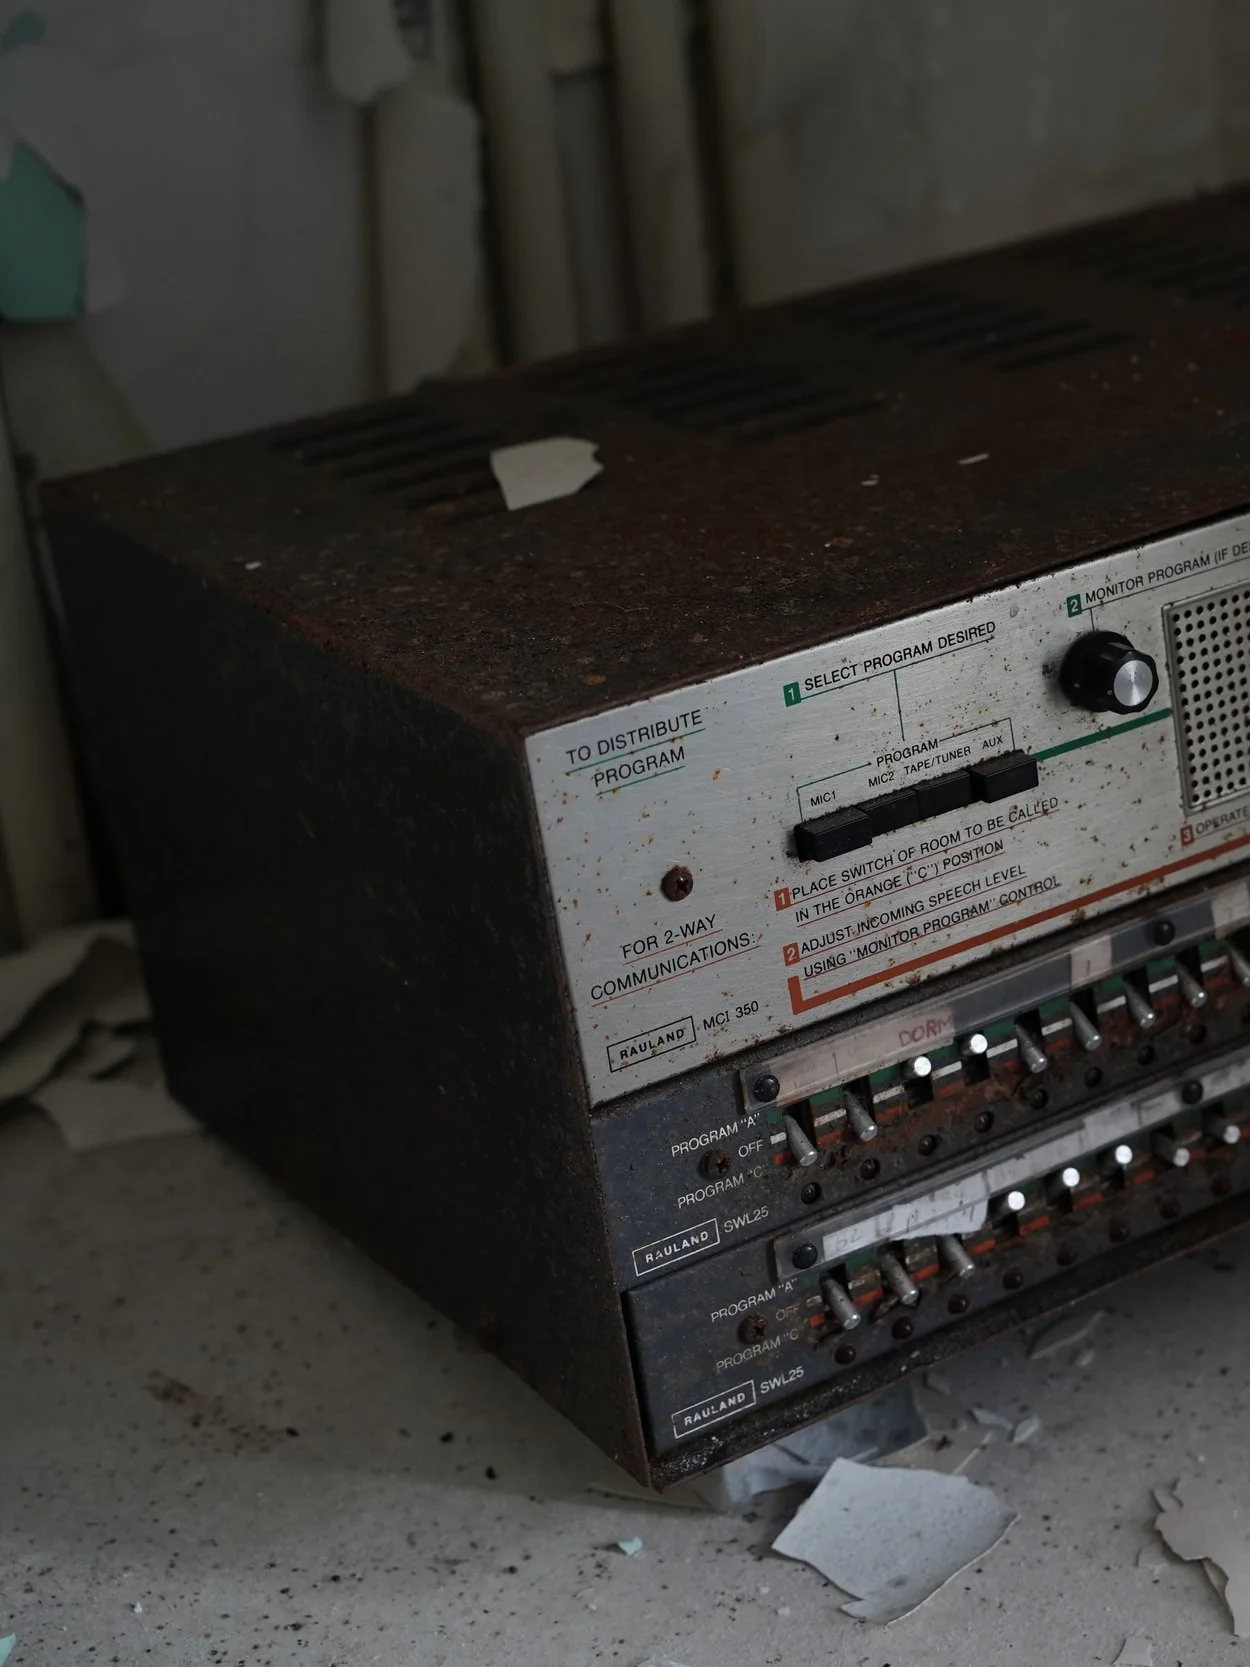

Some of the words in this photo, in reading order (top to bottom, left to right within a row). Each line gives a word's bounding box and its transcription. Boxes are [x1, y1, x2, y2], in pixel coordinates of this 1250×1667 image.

[1085, 575, 1144, 604] MONITOR
[1148, 554, 1211, 584] PROGRAM
[1214, 548, 1229, 566] (IF
[804, 664, 858, 691] SELECT
[863, 641, 934, 673] PROGRAM
[938, 621, 996, 649] DESIRED
[565, 745, 592, 765] TO
[597, 709, 703, 756] DISTRIBUTE
[868, 771, 895, 788] MIC2
[904, 746, 971, 775] TAPE/TUNER
[982, 735, 1003, 750] AUX
[876, 738, 939, 767] PROGRAM
[593, 746, 686, 788] PROGRAM
[810, 790, 837, 808] MIC1
[1195, 806, 1250, 835] OPERATE
[791, 875, 836, 900] PLACE
[842, 857, 894, 882] SWITCH
[897, 847, 916, 863] OF
[920, 831, 962, 856] ROOM
[965, 823, 983, 839] TO
[987, 816, 1004, 832] BE
[1008, 797, 1059, 824] CALLED
[795, 911, 808, 923] IN
[812, 900, 841, 918] THE
[844, 877, 902, 906] ORANGE
[942, 840, 1004, 870] POSITION
[800, 928, 851, 954] ADJUST
[857, 901, 925, 932] INCOMING
[928, 880, 982, 908] SPEECH
[985, 864, 1026, 888] LEVEL
[803, 953, 847, 978] USING
[999, 875, 1062, 906] CONTROL
[622, 935, 660, 959] FOR
[664, 914, 717, 944] 2-WAY
[590, 932, 757, 1000] COMMUNICATIONS:
[619, 1028, 685, 1060] RAULAND
[702, 1010, 731, 1031] MCI
[735, 1000, 760, 1019] 350
[898, 1015, 954, 1048] DORM
[671, 1122, 739, 1157] PROGRAM
[738, 1139, 764, 1158] OFF
[677, 1173, 745, 1209] PROGRAM
[645, 1230, 709, 1264] RAULAND
[723, 1205, 769, 1234] SWL25
[711, 1287, 776, 1323] PROGRAM
[775, 1304, 801, 1322] OFF
[715, 1335, 781, 1372] PROGRAM
[683, 1392, 746, 1427] RAULAND
[759, 1366, 805, 1395] SWL25
